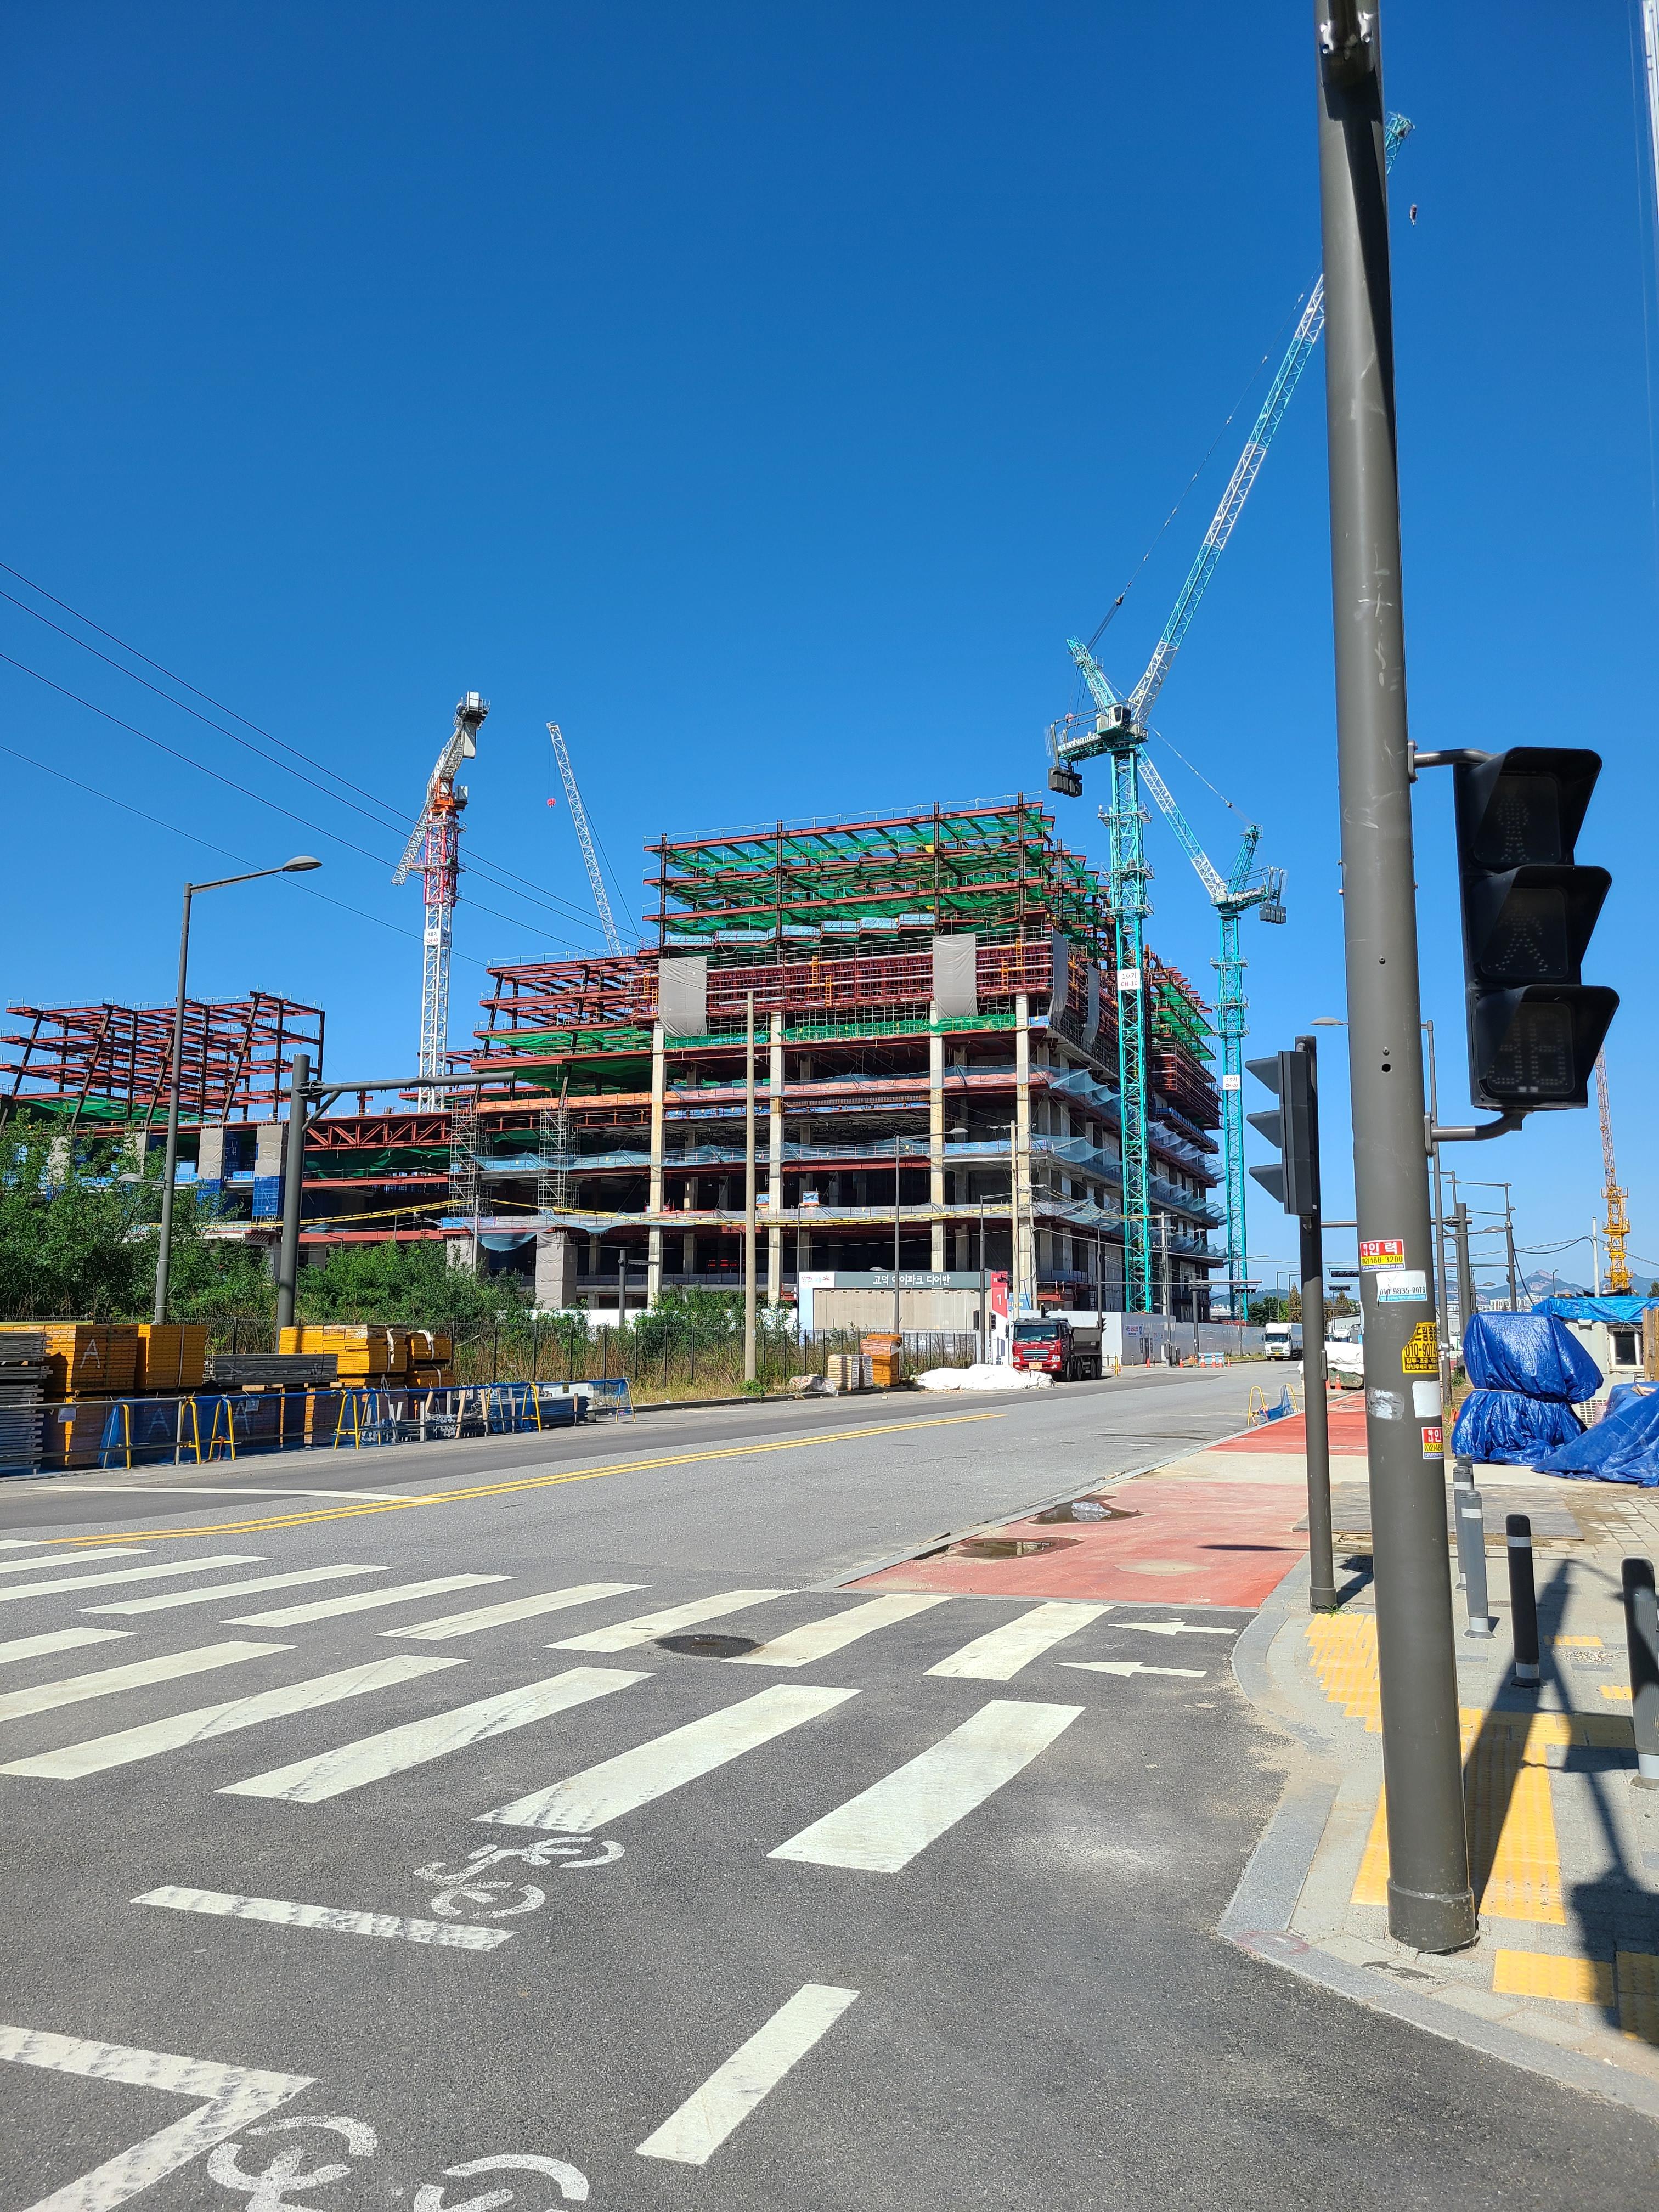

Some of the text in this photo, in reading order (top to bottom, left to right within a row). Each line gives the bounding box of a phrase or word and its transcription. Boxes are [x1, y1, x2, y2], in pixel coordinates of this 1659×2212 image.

[873, 1274, 889, 1286] 고덕
[927, 1274, 951, 1286] 디어반
[996, 1294, 1002, 1306] 1
[80, 1339, 100, 1369] A
